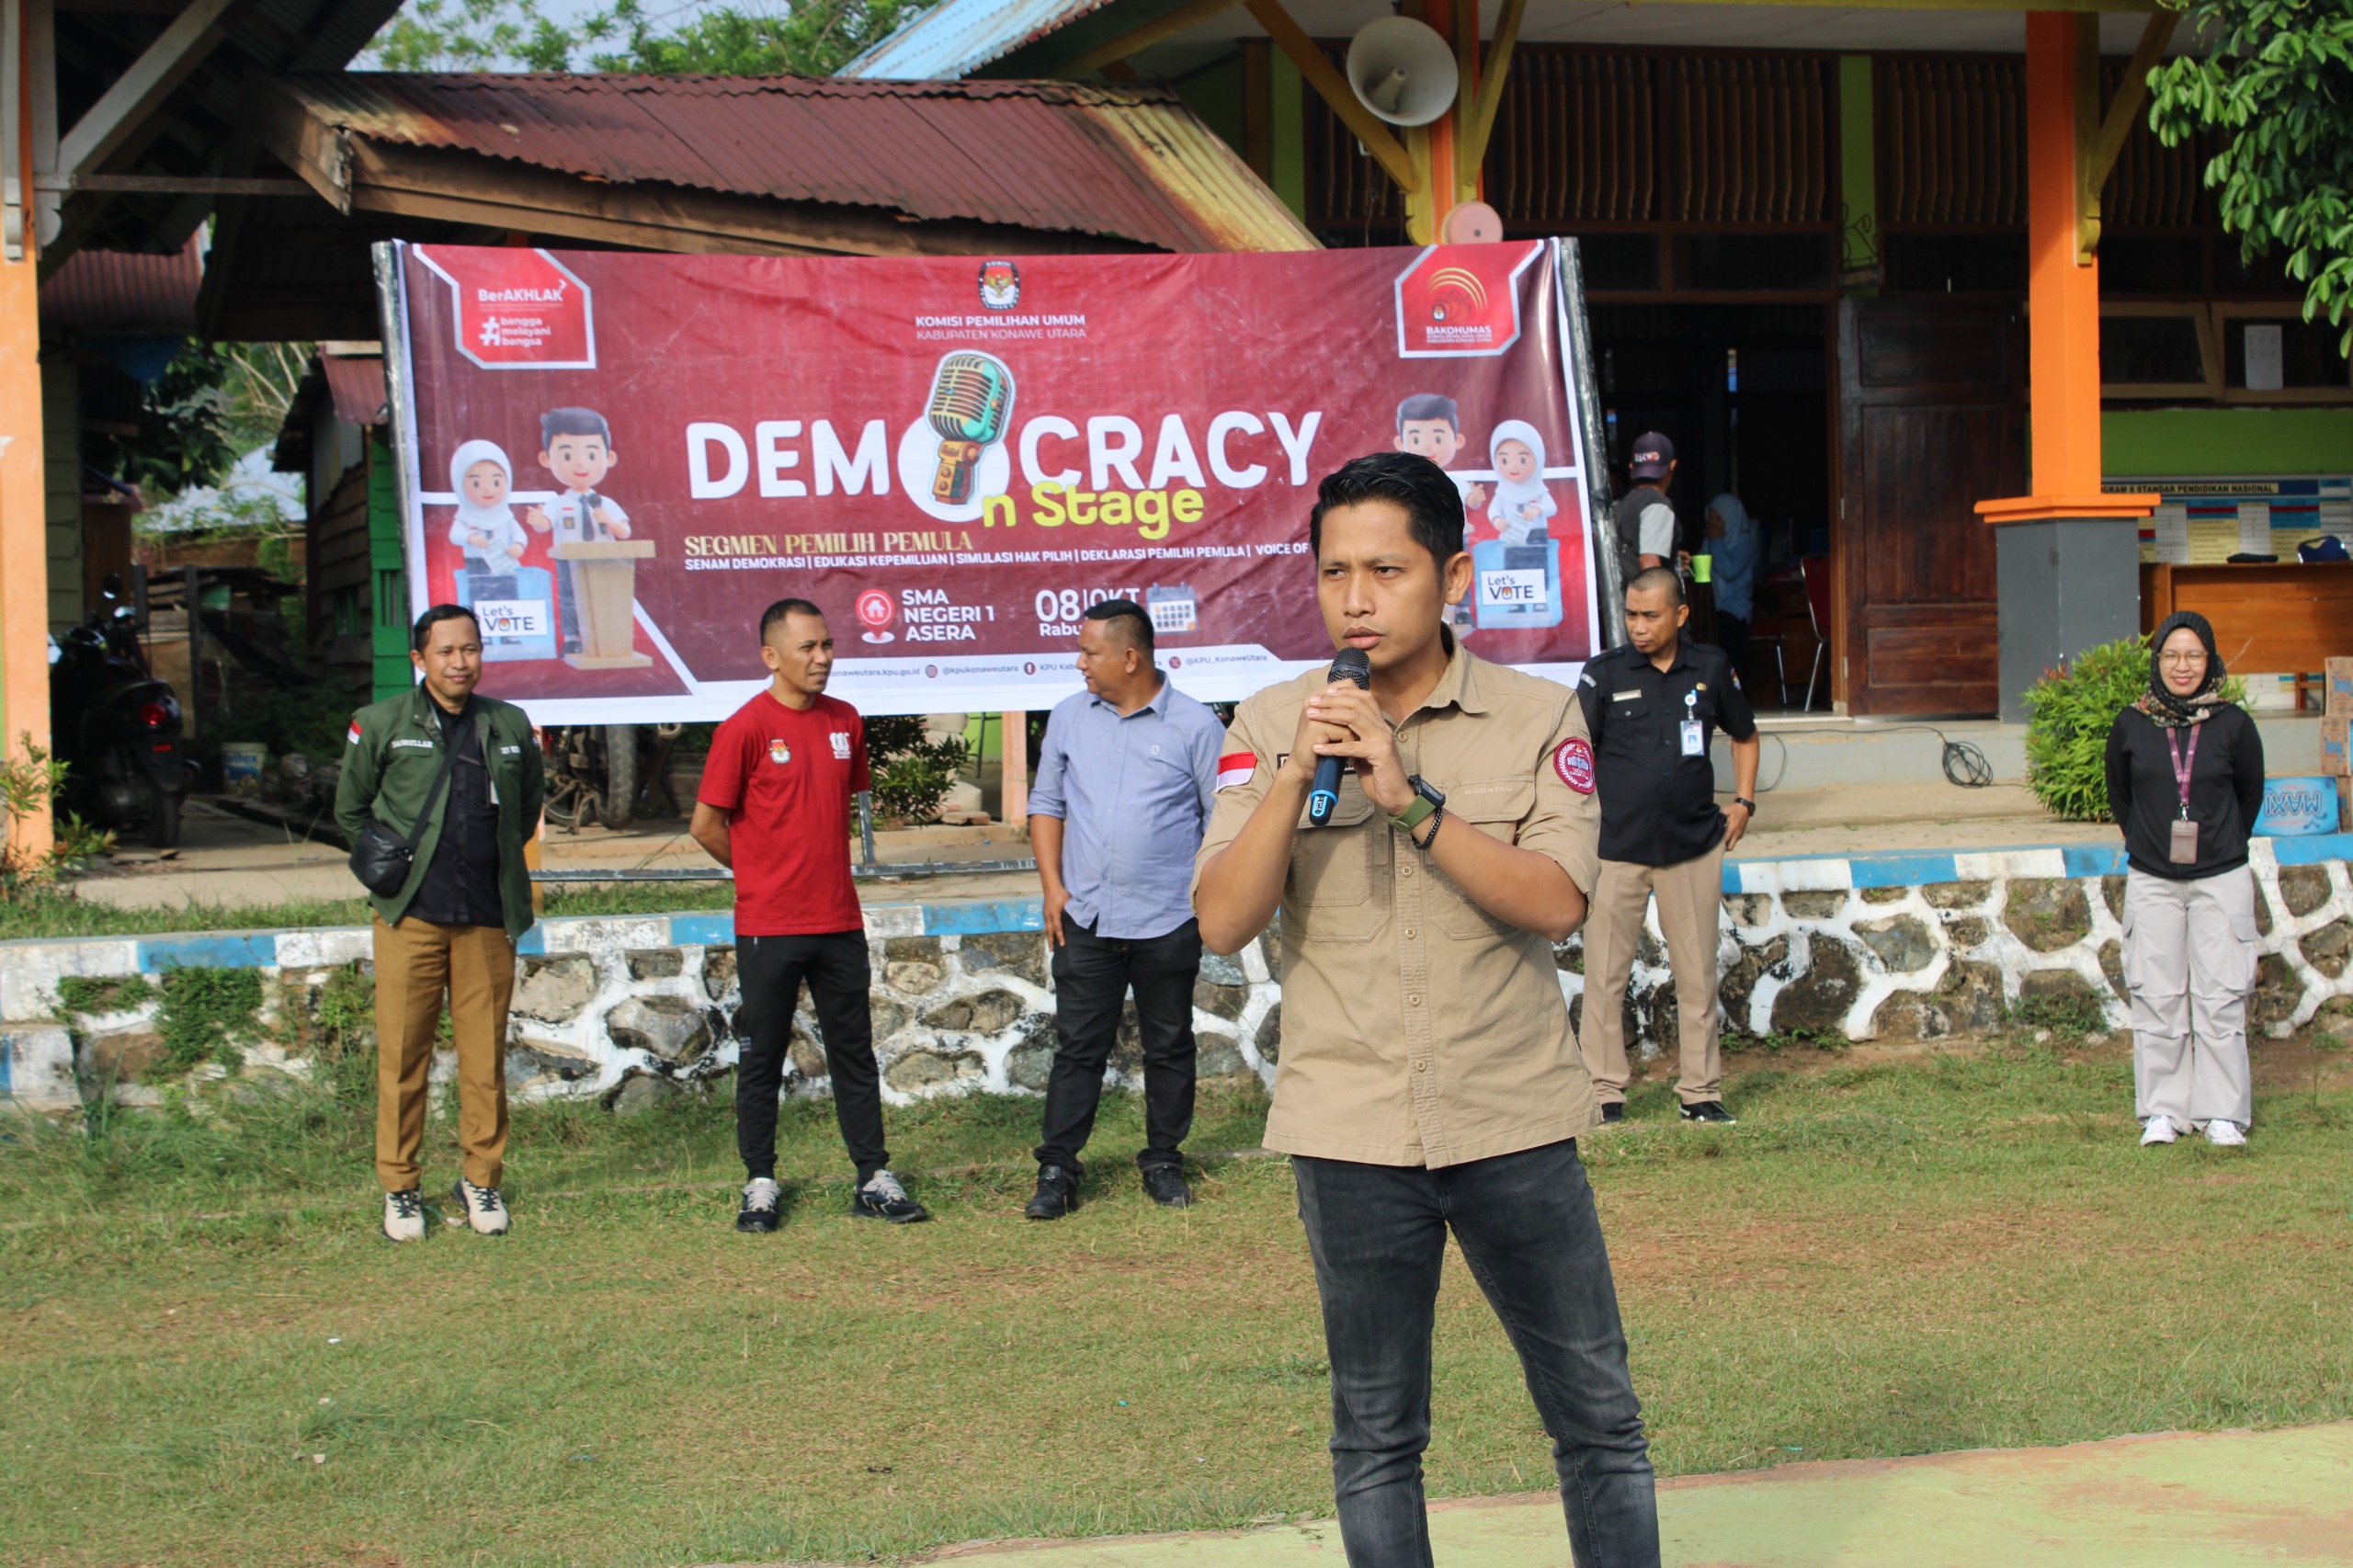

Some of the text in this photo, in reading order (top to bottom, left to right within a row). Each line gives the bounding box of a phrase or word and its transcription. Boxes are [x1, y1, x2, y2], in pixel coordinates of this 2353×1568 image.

[478, 289, 563, 301] BerAKHLAK
[500, 316, 542, 327] bangga
[915, 314, 1086, 327] KOMISI PEMILIHAN UMUM
[501, 326, 551, 337] melayani
[916, 328, 1086, 340] KABUPATEN KONAWE UTARA
[1427, 326, 1491, 335] BAKOHUMAS
[501, 337, 542, 348] bangsa
[2102, 485, 2128, 494] GRAM
[2137, 484, 2176, 494] STANDAR
[2177, 483, 2230, 494] PENDIDIKAN
[2232, 483, 2273, 493] NASIONAL
[1031, 481, 1205, 540] Stage
[684, 531, 973, 556] SEGMEN PEMILIH PEMULA
[685, 542, 1309, 571] SENAM DEMOKRASI EDUKASI KEPEMILUAN SIMULASI HAK PILIH DEKLARASI PEMILIH PEMULA VOICE OF
[1487, 575, 1516, 586] Let's
[902, 589, 949, 606] SMA
[1489, 585, 1534, 600] VOTE
[483, 606, 514, 618] Let's
[904, 605, 995, 623] NEGERI 1
[484, 617, 535, 631] VOTE
[1040, 622, 1083, 636] Rabu
[905, 624, 976, 642] ASERA
[942, 665, 1018, 676] @kpukonaweutara
[1040, 664, 1057, 672] KPU
[1186, 654, 1267, 665] @KPU_KonaweUtara
[2264, 790, 2323, 817] MAXI
